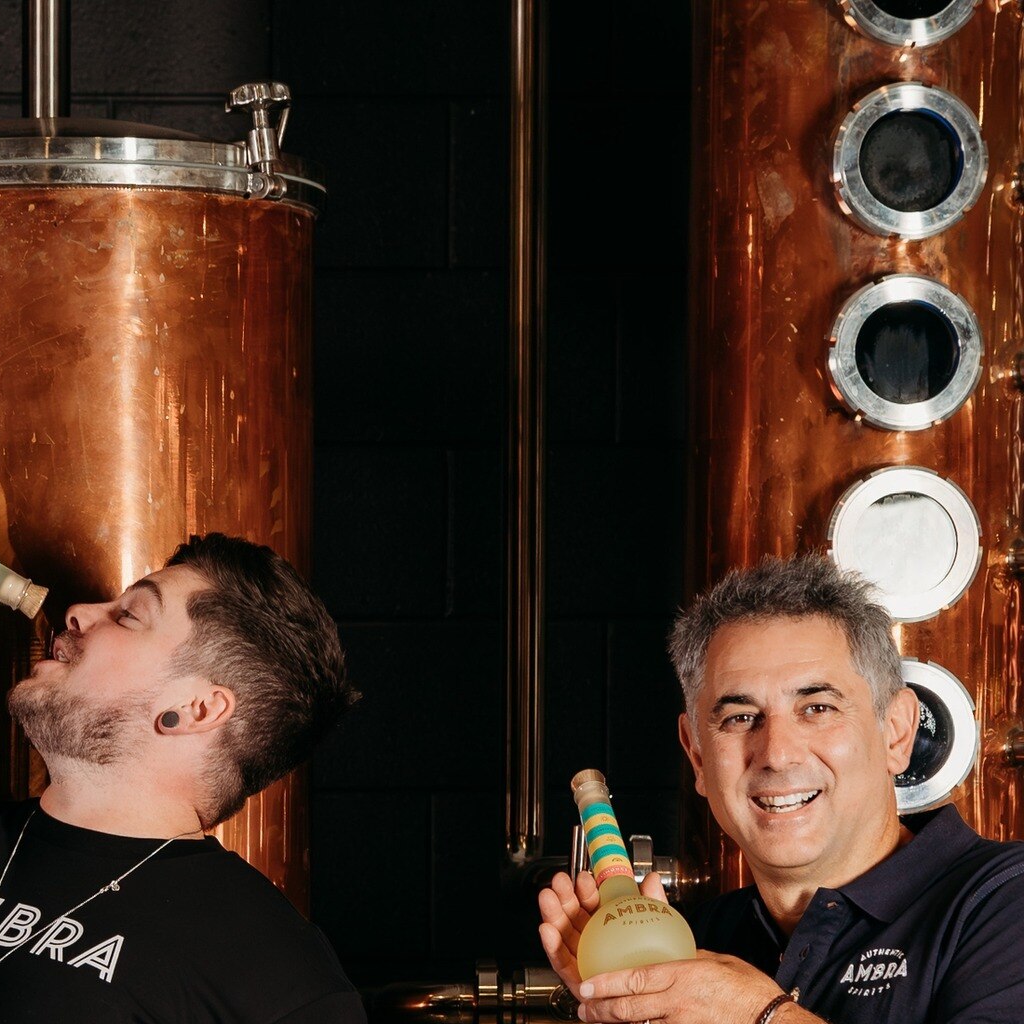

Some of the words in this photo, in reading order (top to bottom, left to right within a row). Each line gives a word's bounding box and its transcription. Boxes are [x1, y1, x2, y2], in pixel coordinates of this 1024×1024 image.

[603, 903, 673, 926] AMBRA
[623, 917, 660, 926] SPIRITS
[860, 948, 904, 961] AUTHENTIC
[840, 958, 907, 983] AMBRA
[848, 983, 890, 996] SPIRITS
